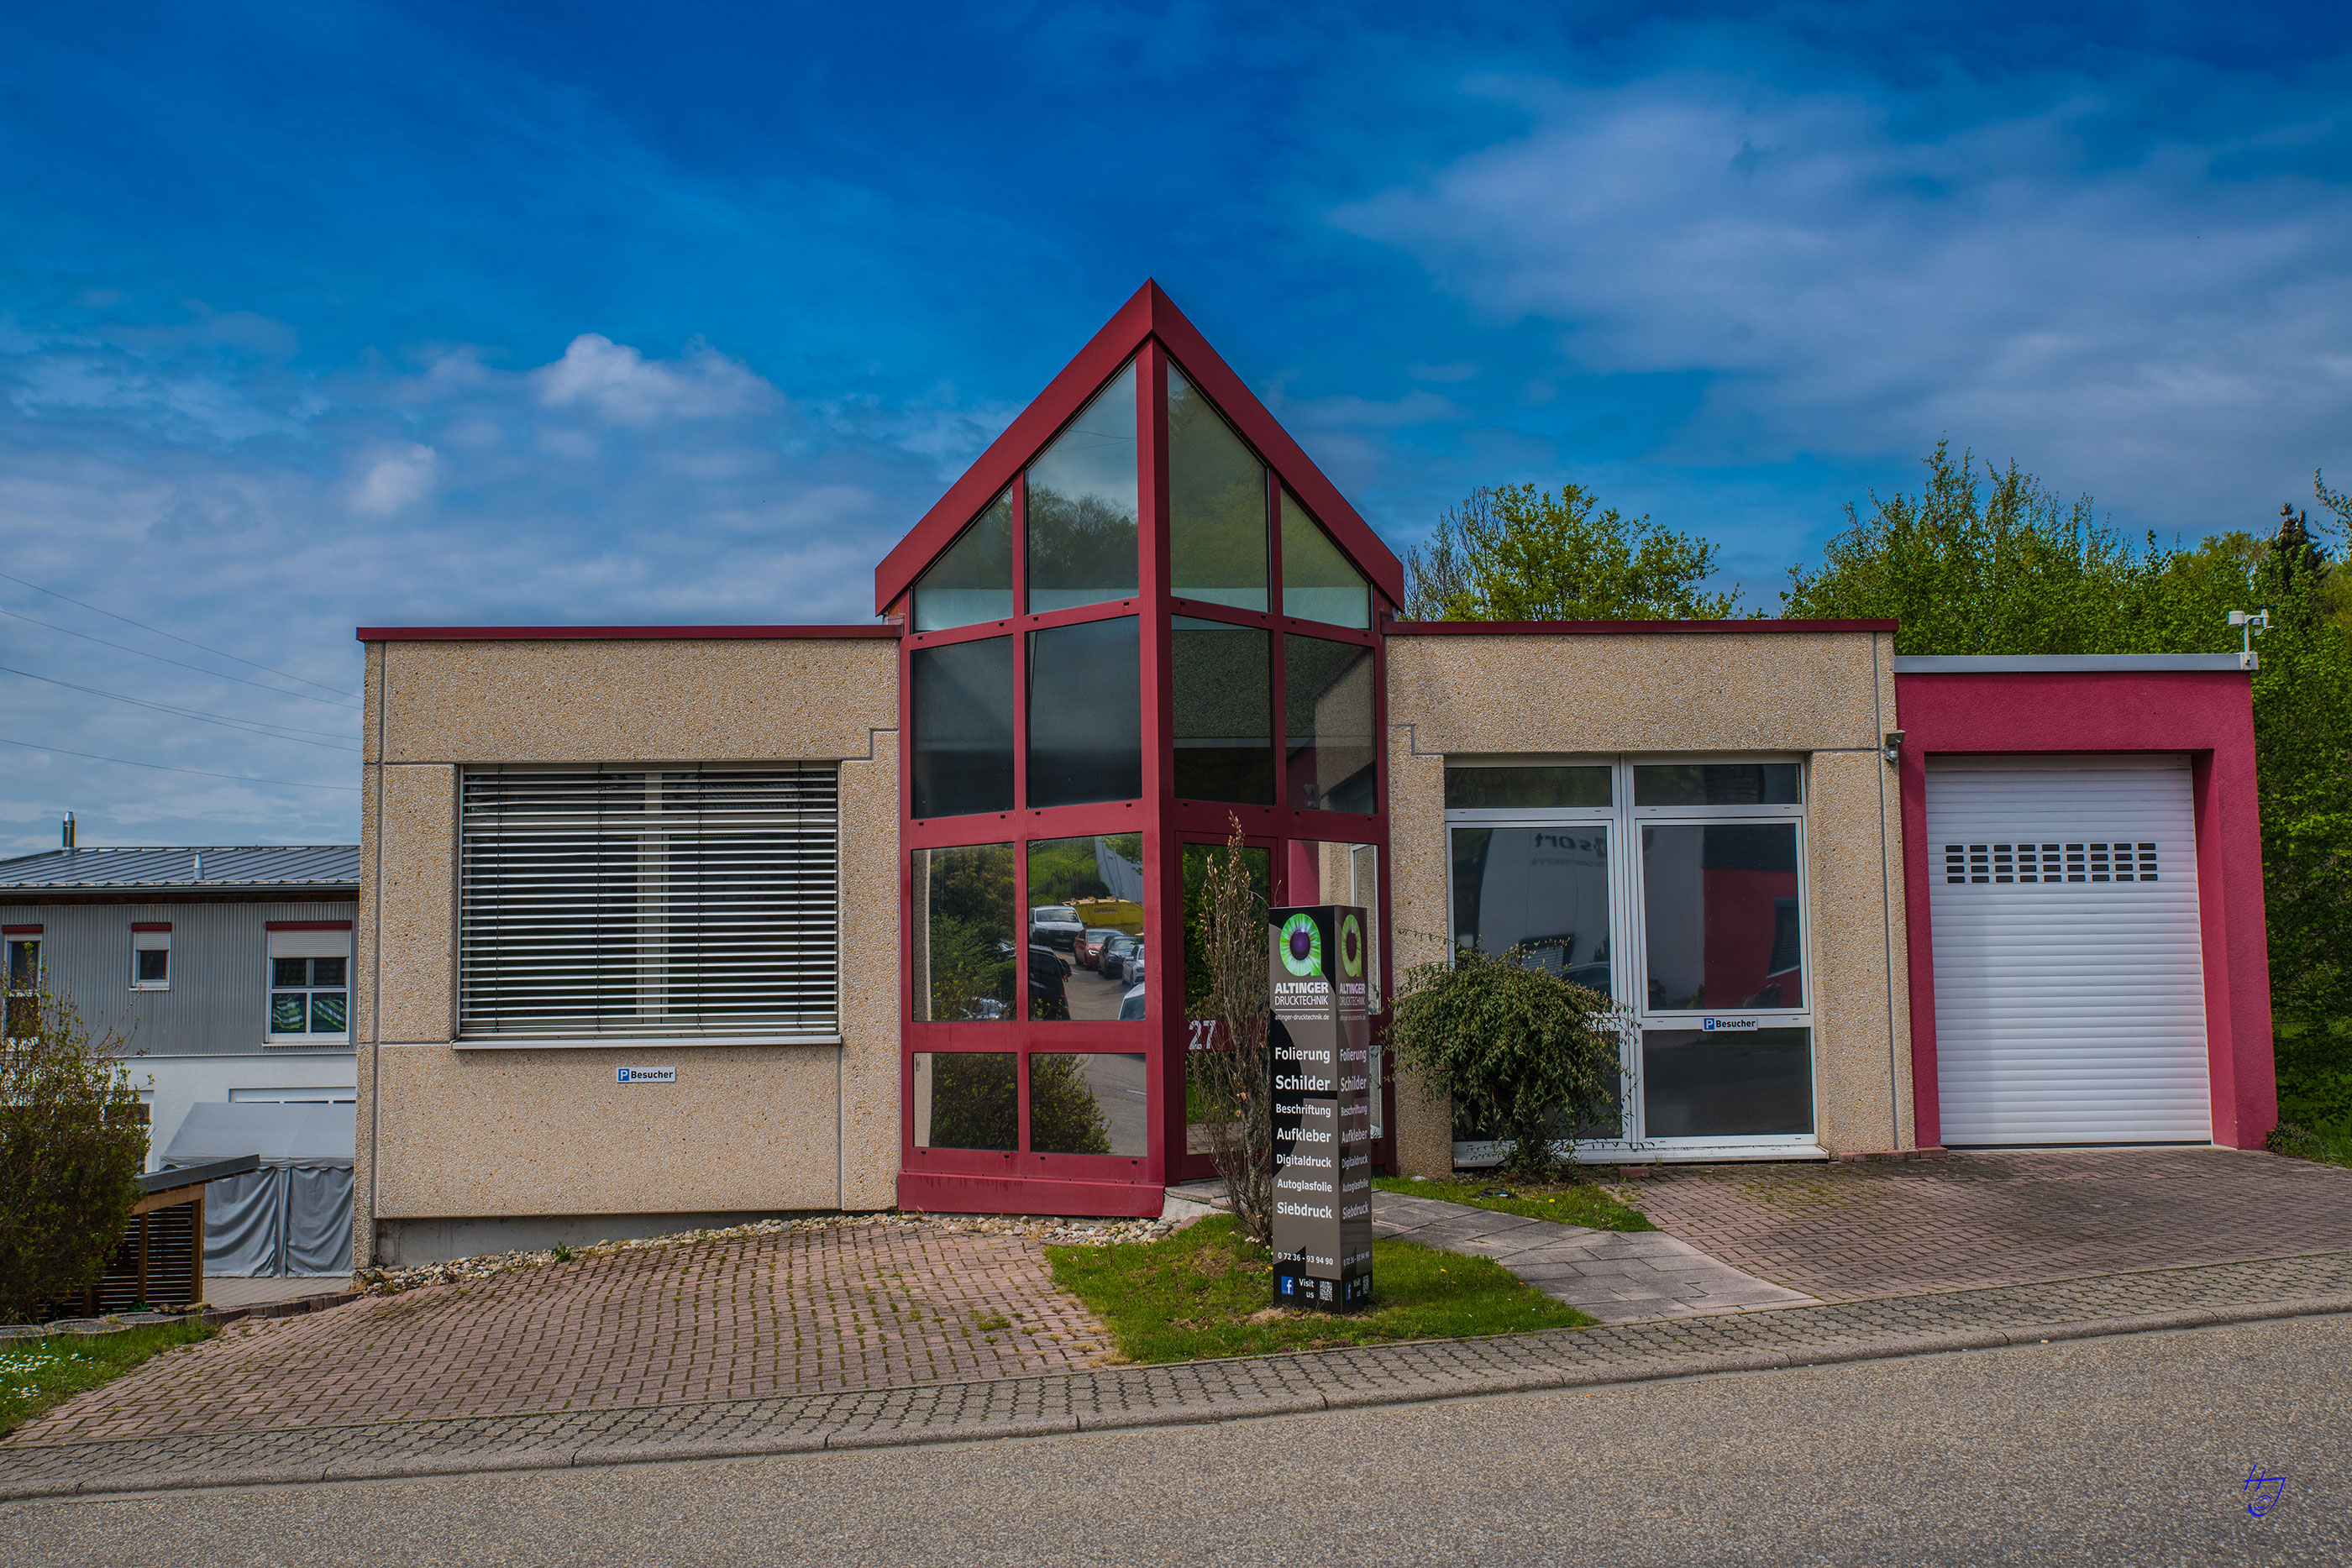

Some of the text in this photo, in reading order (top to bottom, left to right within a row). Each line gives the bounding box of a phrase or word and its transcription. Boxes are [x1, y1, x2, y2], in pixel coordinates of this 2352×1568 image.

[1274, 982, 1329, 994] ALTINGER
[1339, 983, 1366, 994] ALTINGER
[1274, 995, 1329, 1005] DRUCKTECHNIK
[1706, 1019, 1756, 1029] P Besucher
[1188, 1020, 1216, 1050] 27
[1275, 1046, 1331, 1064] Folierung
[1340, 1048, 1367, 1063] Folierung
[620, 1070, 628, 1080] P
[1275, 1074, 1331, 1091] Schilder
[1340, 1075, 1367, 1092] Schilder
[1276, 1104, 1331, 1118] Beschriftung
[1341, 1104, 1368, 1117] Beschriftung
[1276, 1127, 1331, 1143] Aufkleber
[1341, 1128, 1368, 1144] Aufkleber
[1276, 1154, 1332, 1168] Digitaldruck
[1341, 1153, 1368, 1169] Digitaldruck
[1277, 1178, 1332, 1193] Autoglasfolie
[1341, 1177, 1369, 1193] Autoglasfolie
[1277, 1201, 1332, 1219] Siebdruck
[1342, 1202, 1369, 1219] Siebdruck
[1284, 1252, 1292, 1261] 72
[1293, 1253, 1301, 1261] 36
[1306, 1255, 1315, 1263] 93
[1315, 1256, 1324, 1264] 94
[1325, 1257, 1334, 1266] 90
[1299, 1277, 1315, 1288] Visit
